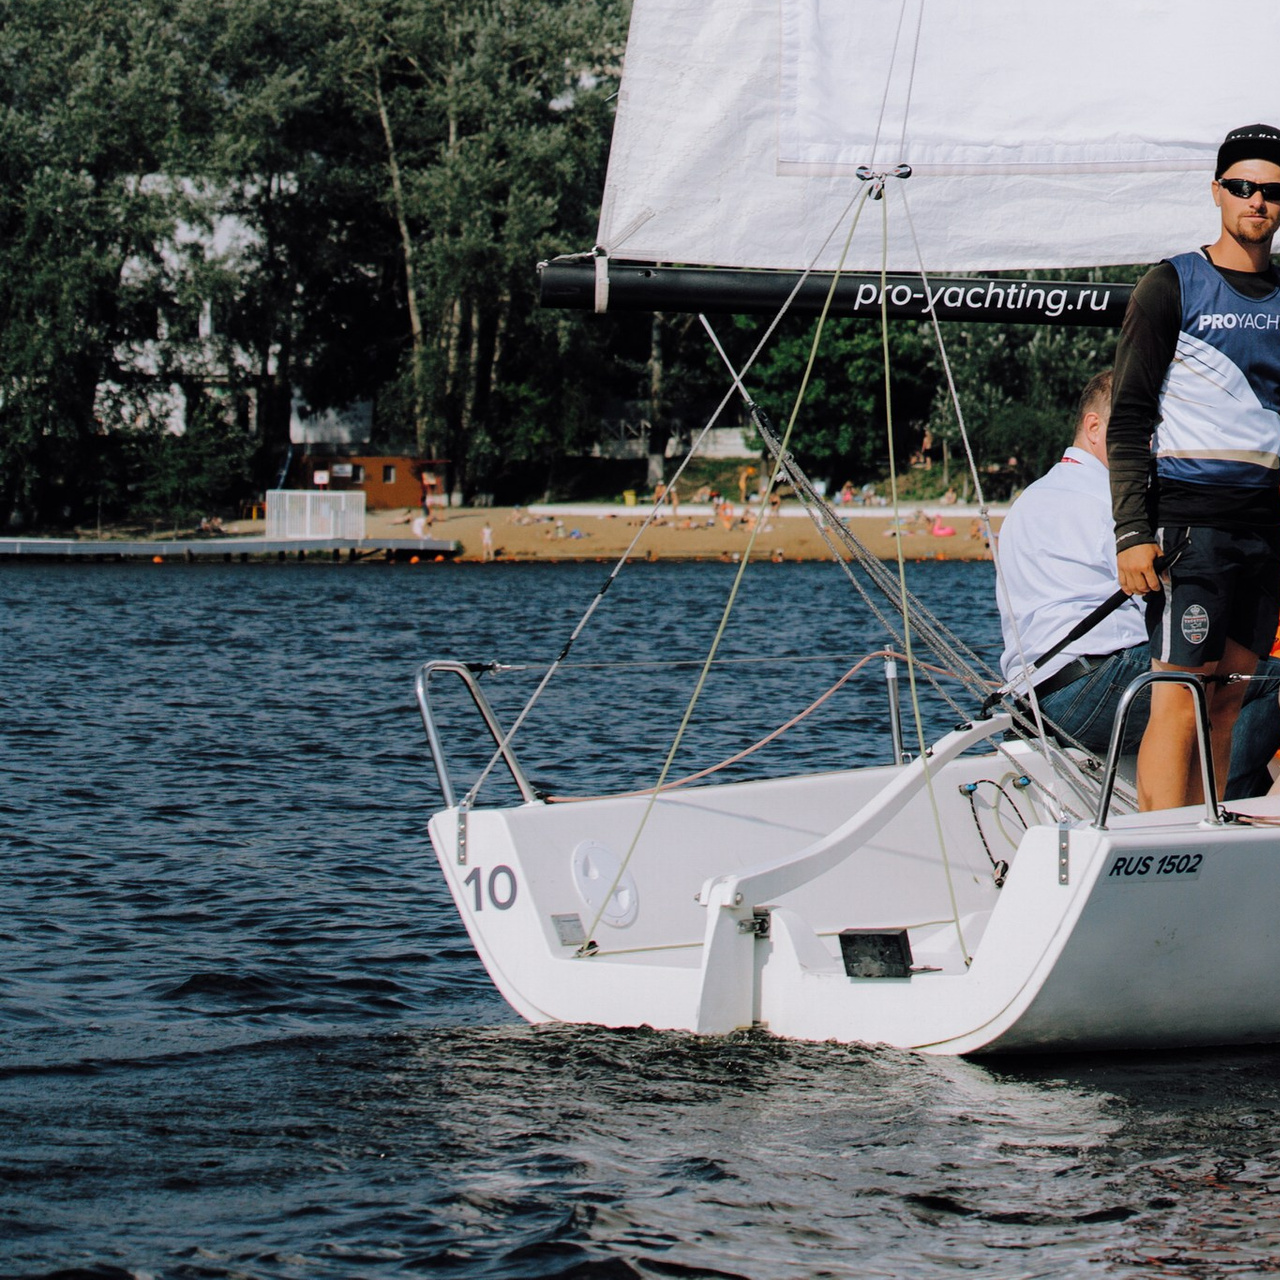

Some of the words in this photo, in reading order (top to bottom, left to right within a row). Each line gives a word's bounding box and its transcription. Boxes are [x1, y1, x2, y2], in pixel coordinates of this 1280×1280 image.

[853, 282, 1111, 317] pro-yachting.ru
[1108, 855, 1154, 877] RUS
[1156, 853, 1203, 875] 1502
[464, 864, 518, 912] 10
